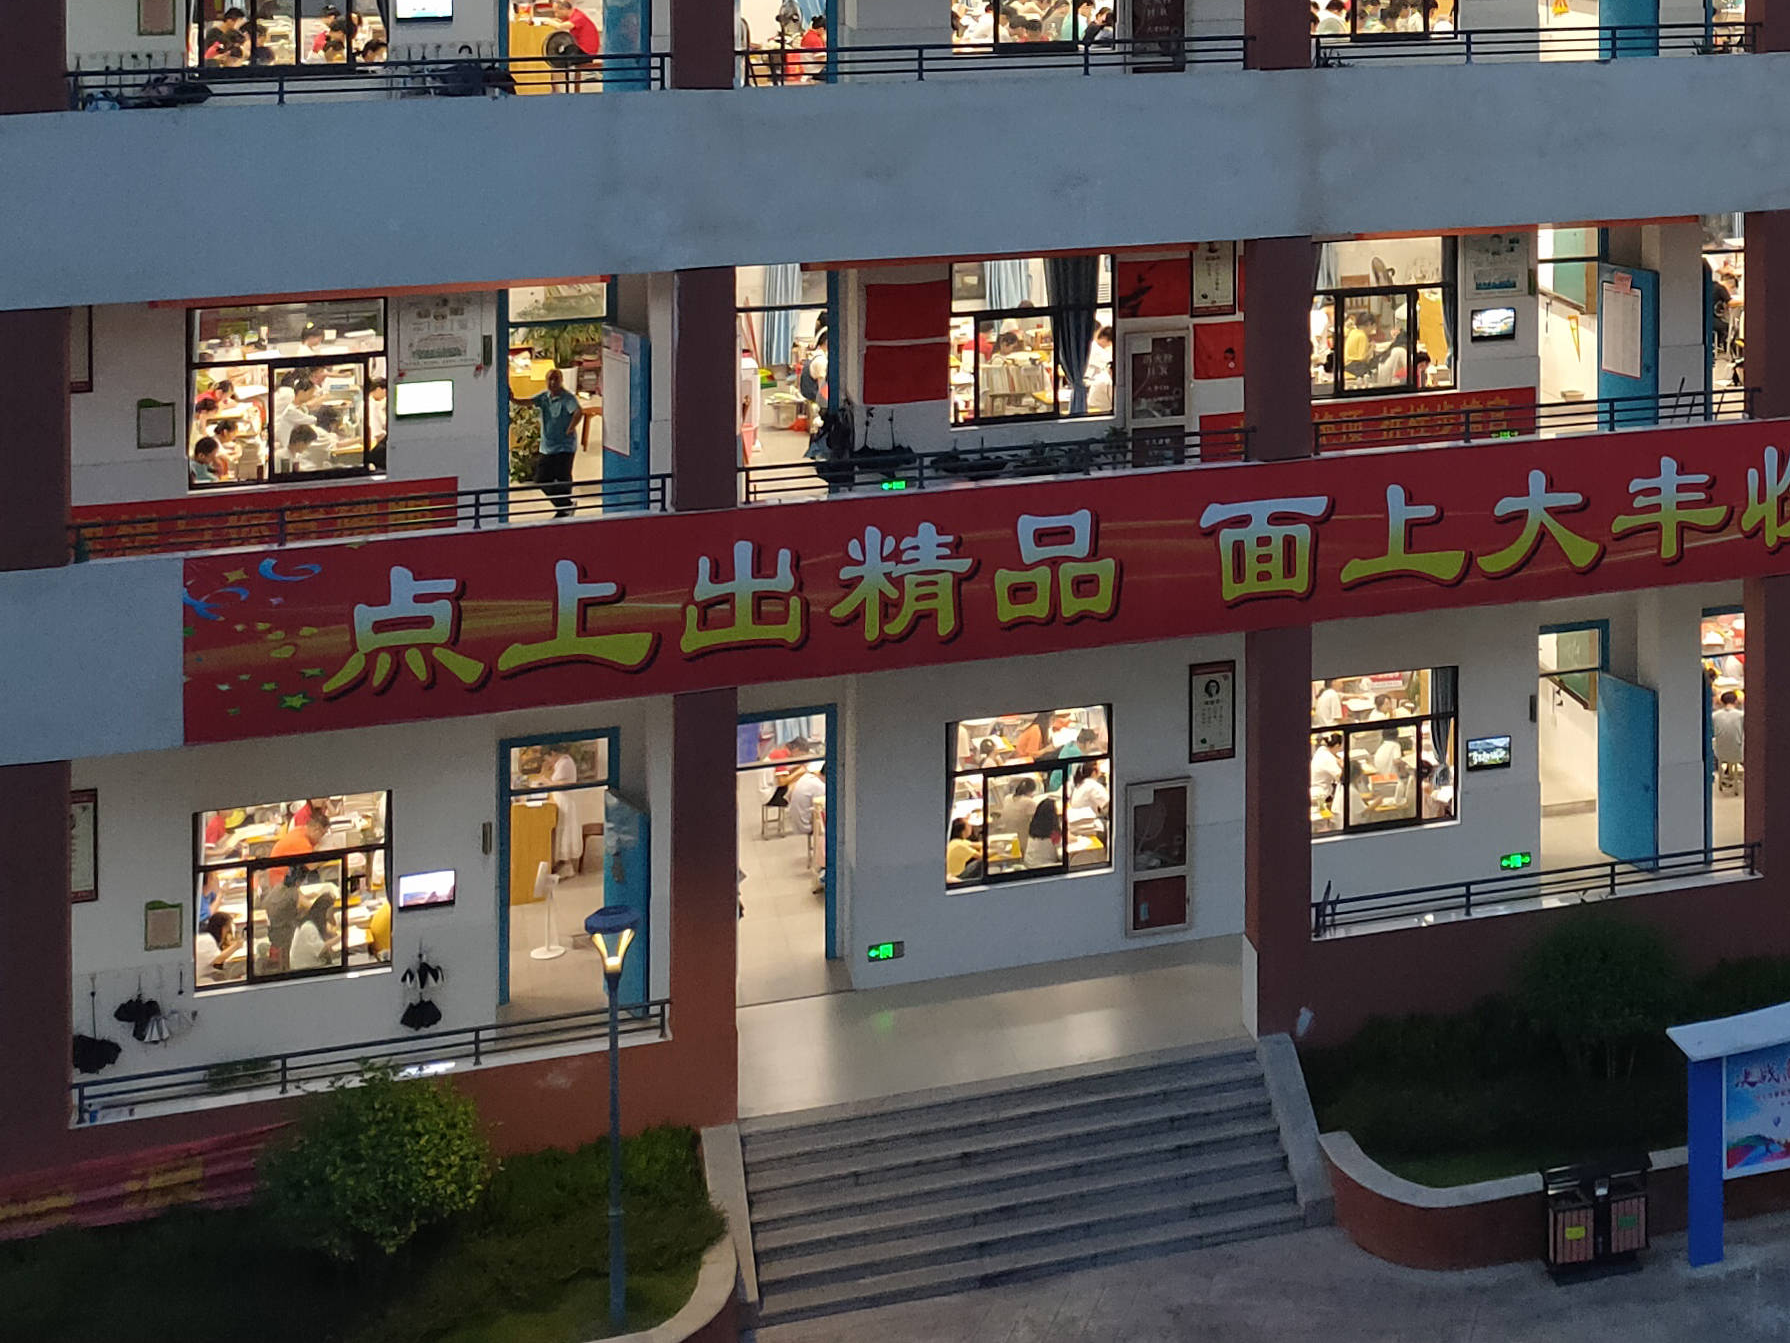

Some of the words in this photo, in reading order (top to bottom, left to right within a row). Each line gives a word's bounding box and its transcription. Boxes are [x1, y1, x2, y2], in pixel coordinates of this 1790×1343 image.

[322, 507, 1118, 694] 点上出精品
